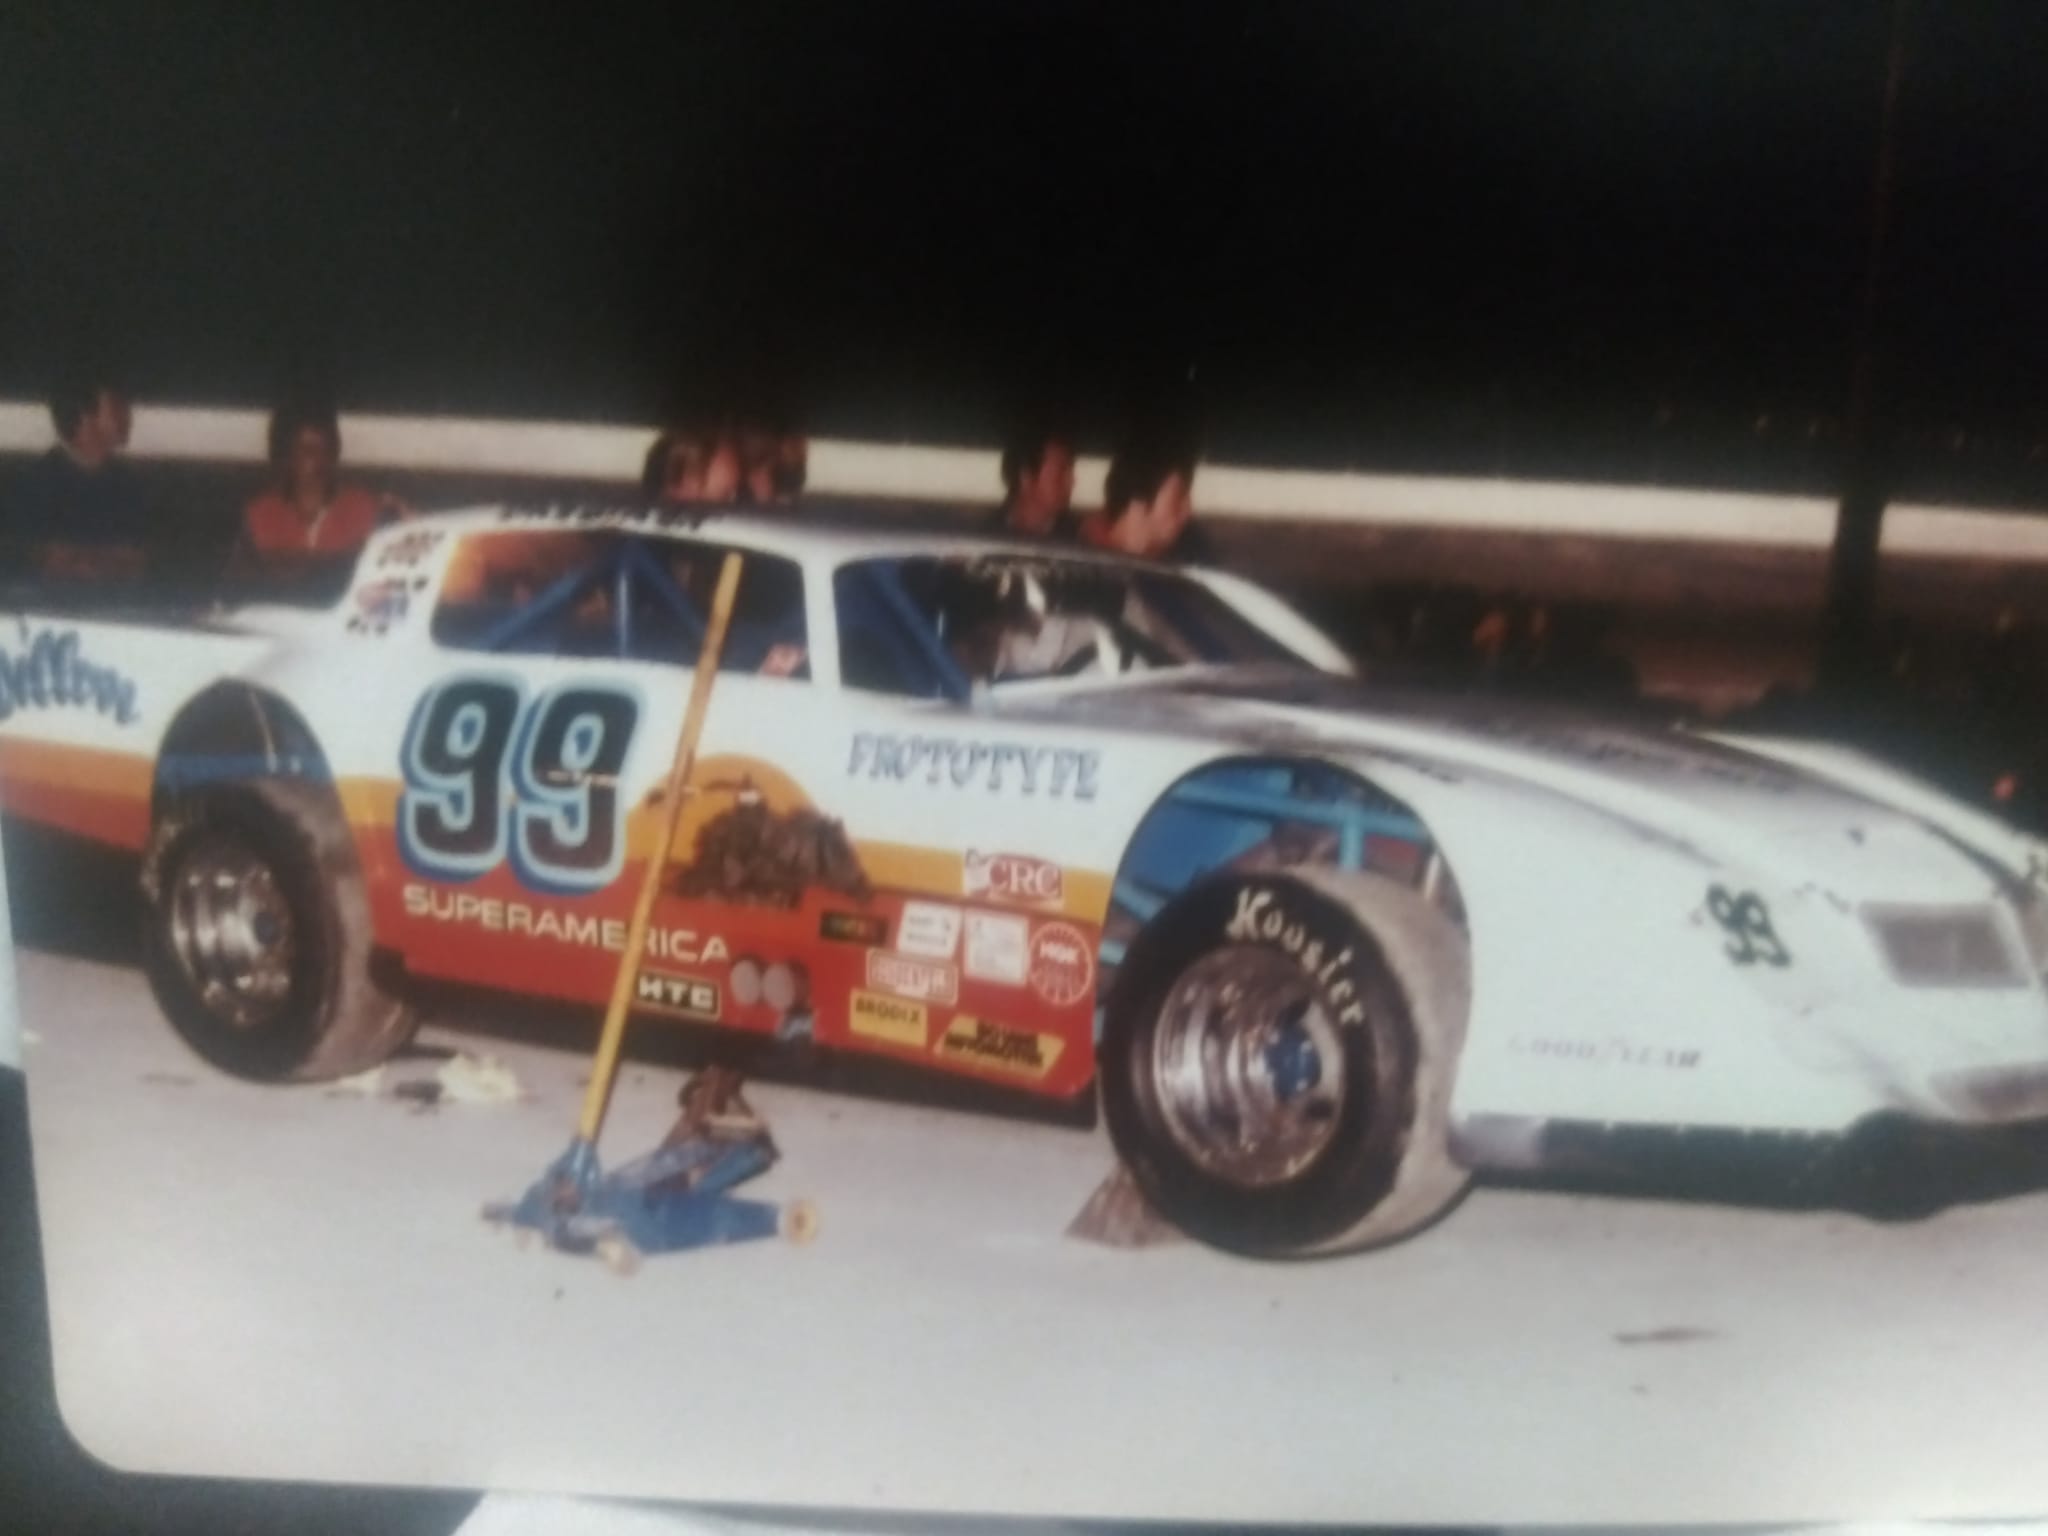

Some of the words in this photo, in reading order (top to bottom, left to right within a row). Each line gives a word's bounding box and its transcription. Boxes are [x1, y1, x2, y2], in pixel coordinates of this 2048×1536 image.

[398, 671, 642, 893] 99
[986, 858, 1061, 897] CRC
[1705, 881, 1793, 968] 99
